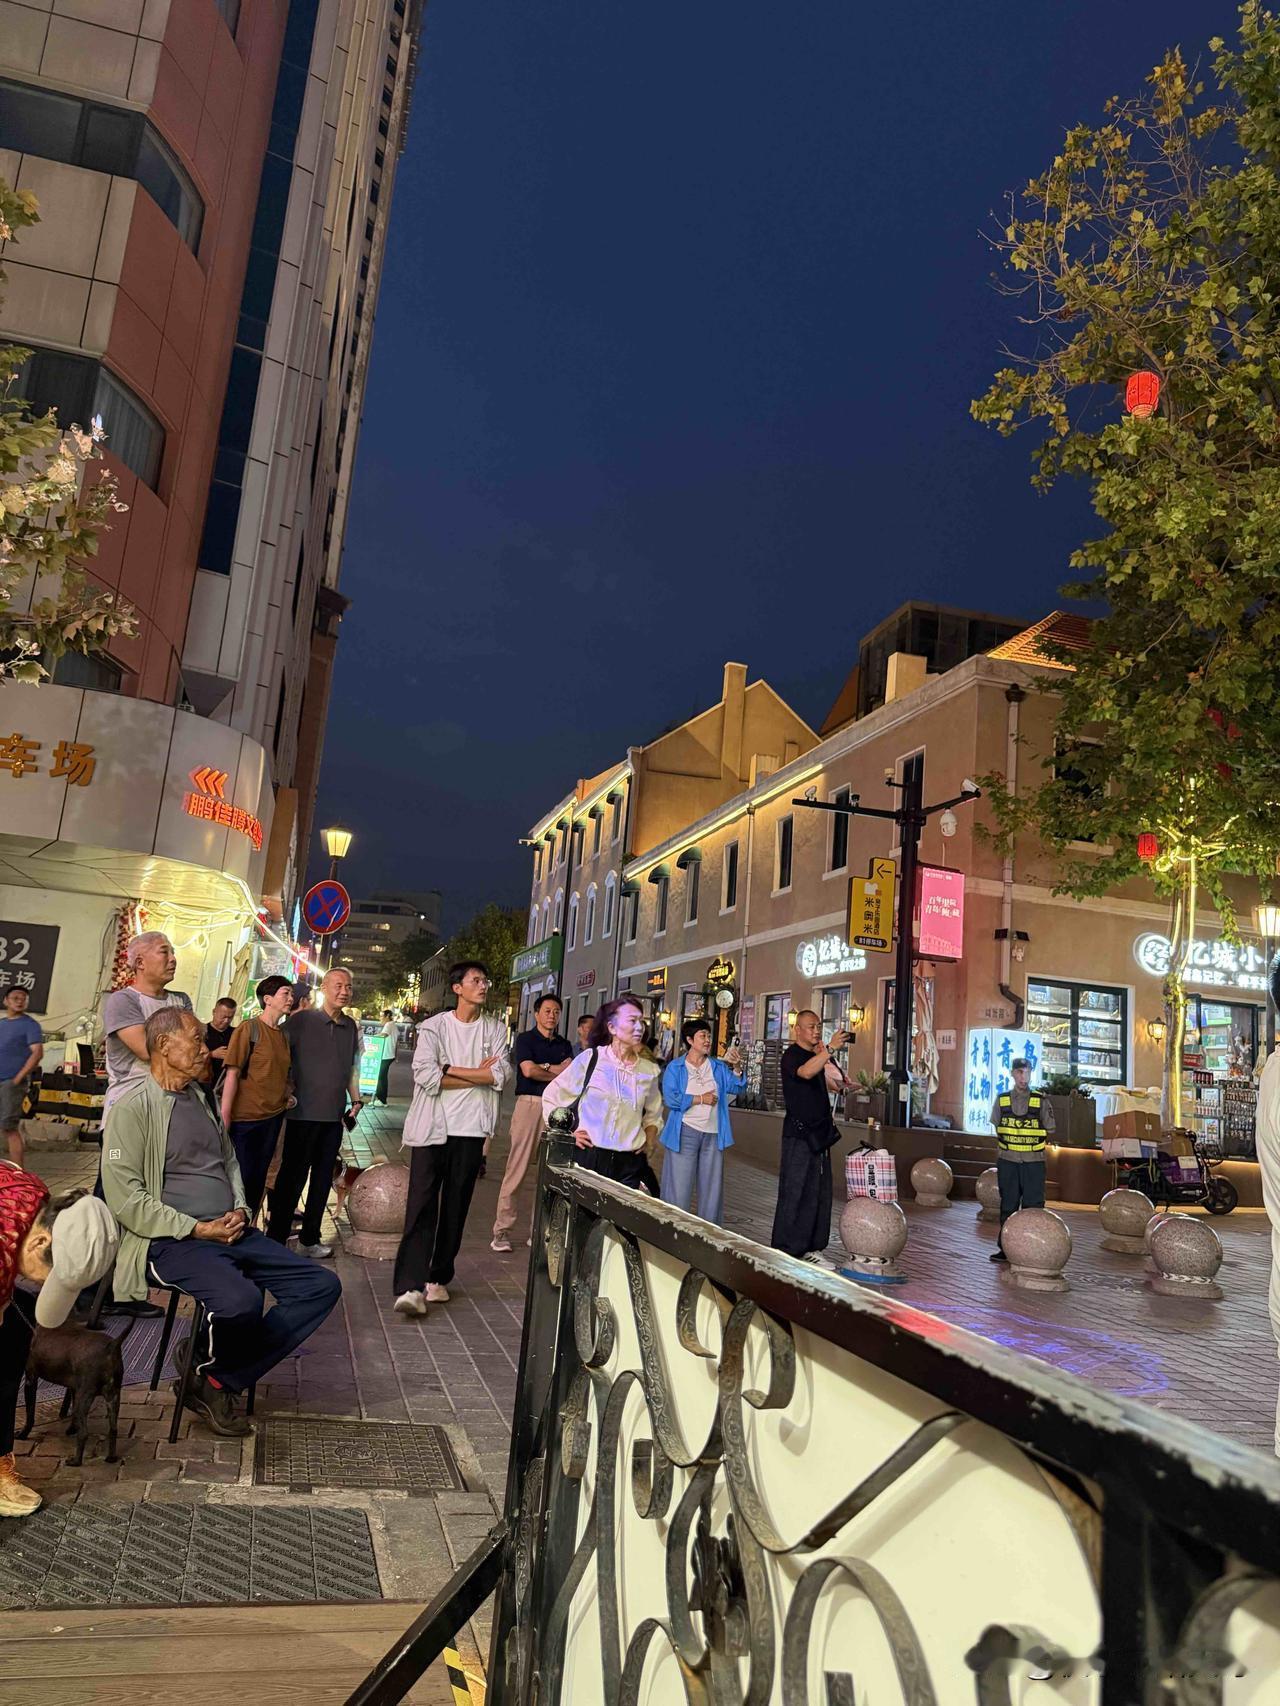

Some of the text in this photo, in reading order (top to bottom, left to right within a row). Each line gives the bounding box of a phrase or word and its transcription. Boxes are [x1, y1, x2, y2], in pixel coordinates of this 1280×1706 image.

[971, 1036, 990, 1067] 青岛
[997, 1037, 1038, 1071] 青岛
[969, 1072, 991, 1101] 礼物
